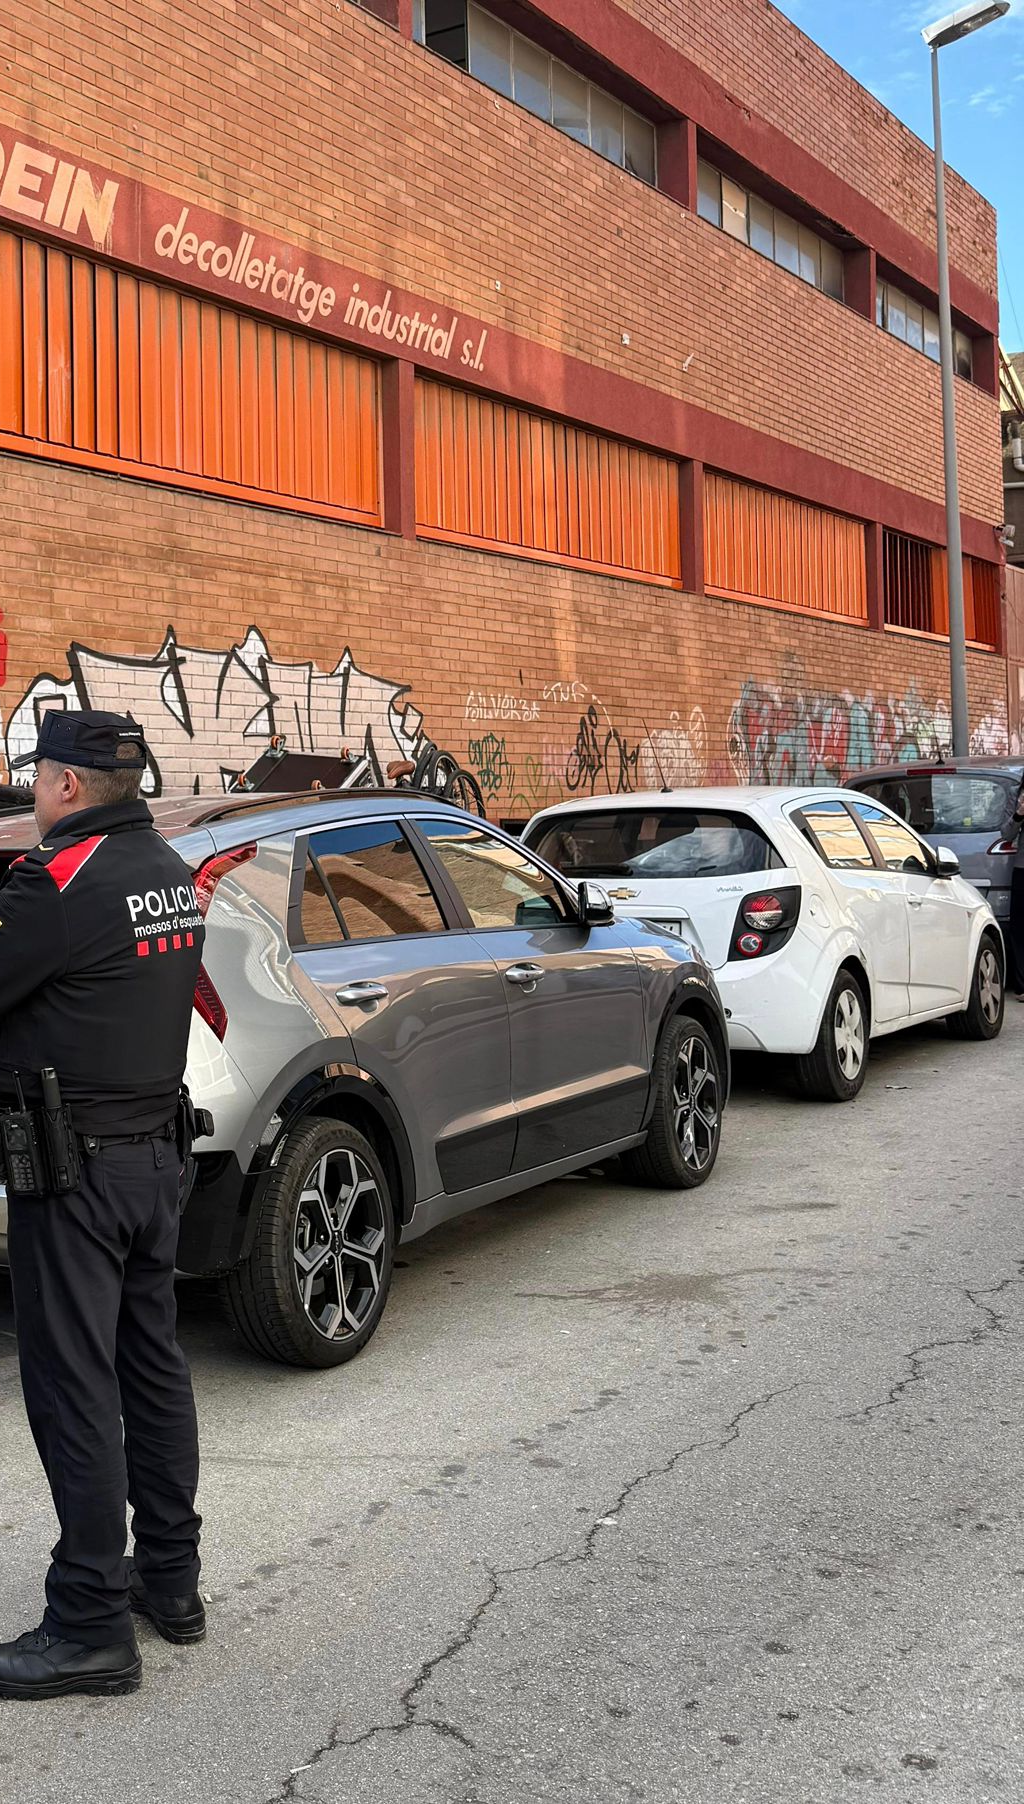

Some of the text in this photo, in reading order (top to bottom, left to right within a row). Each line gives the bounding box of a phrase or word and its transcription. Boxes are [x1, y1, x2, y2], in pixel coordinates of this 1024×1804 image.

[155, 207, 335, 325] decolletatge
[343, 283, 457, 359] industrial
[460, 330, 485, 371] s.l.
[134, 919, 172, 938] mossos
